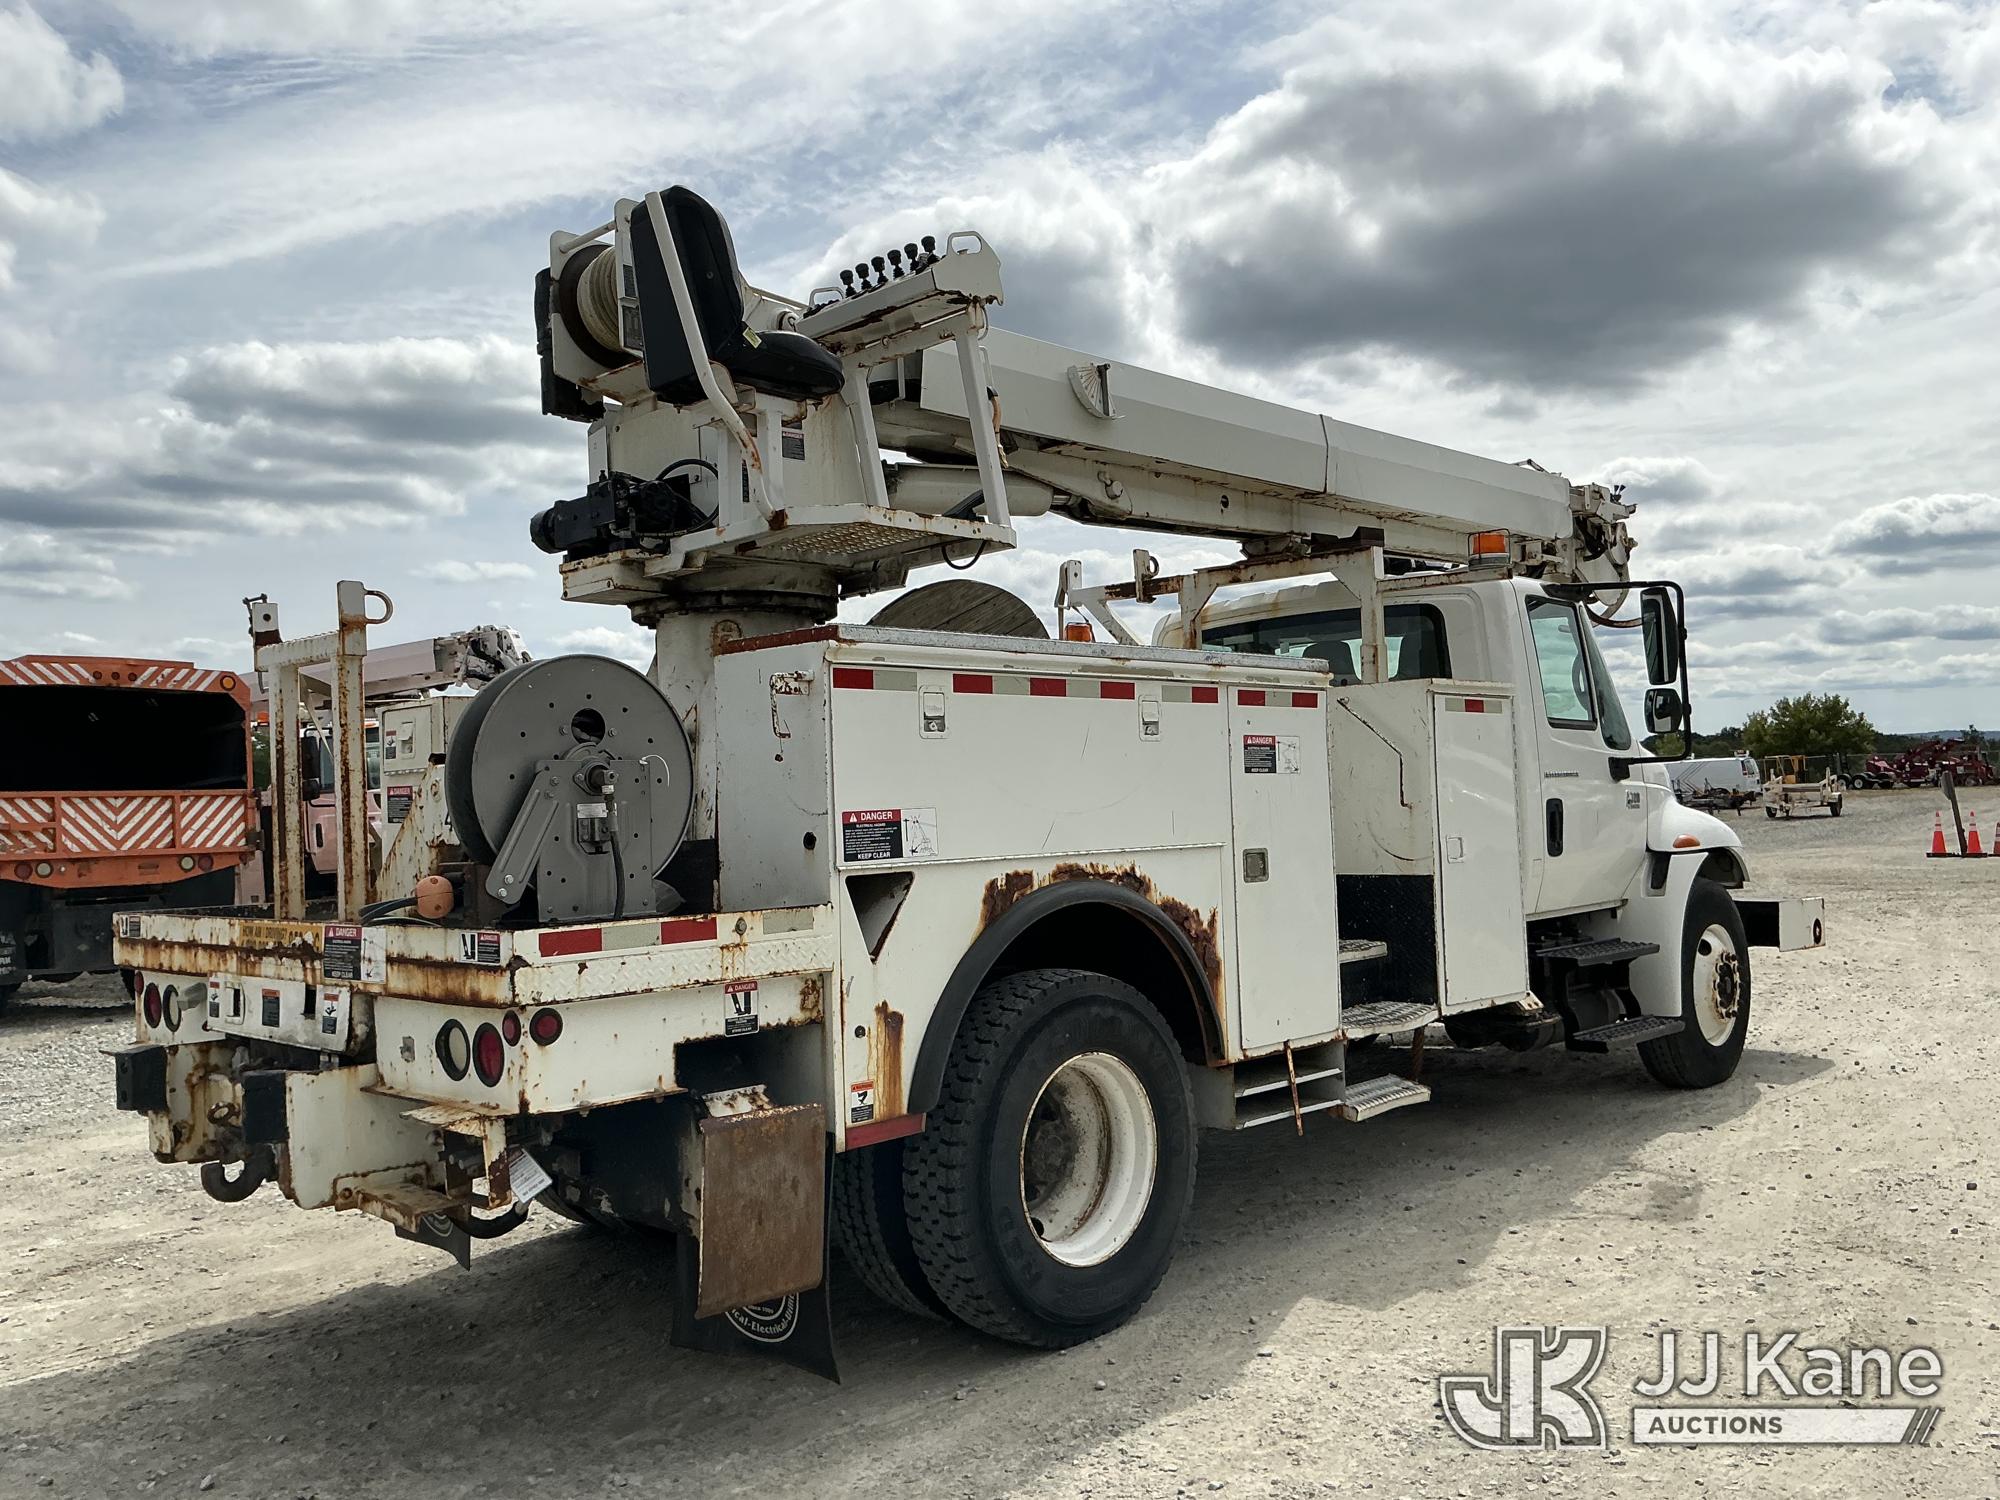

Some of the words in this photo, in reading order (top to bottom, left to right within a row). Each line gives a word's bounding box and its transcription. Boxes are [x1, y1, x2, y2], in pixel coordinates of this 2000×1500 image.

[1252, 736, 1273, 744] DANGER
[860, 811, 893, 821] DANGER
[857, 852, 872, 860] KEEP
[872, 851, 891, 859] CLEAR
[335, 927, 357, 937] DANGER
[734, 983, 755, 991] DANGER
